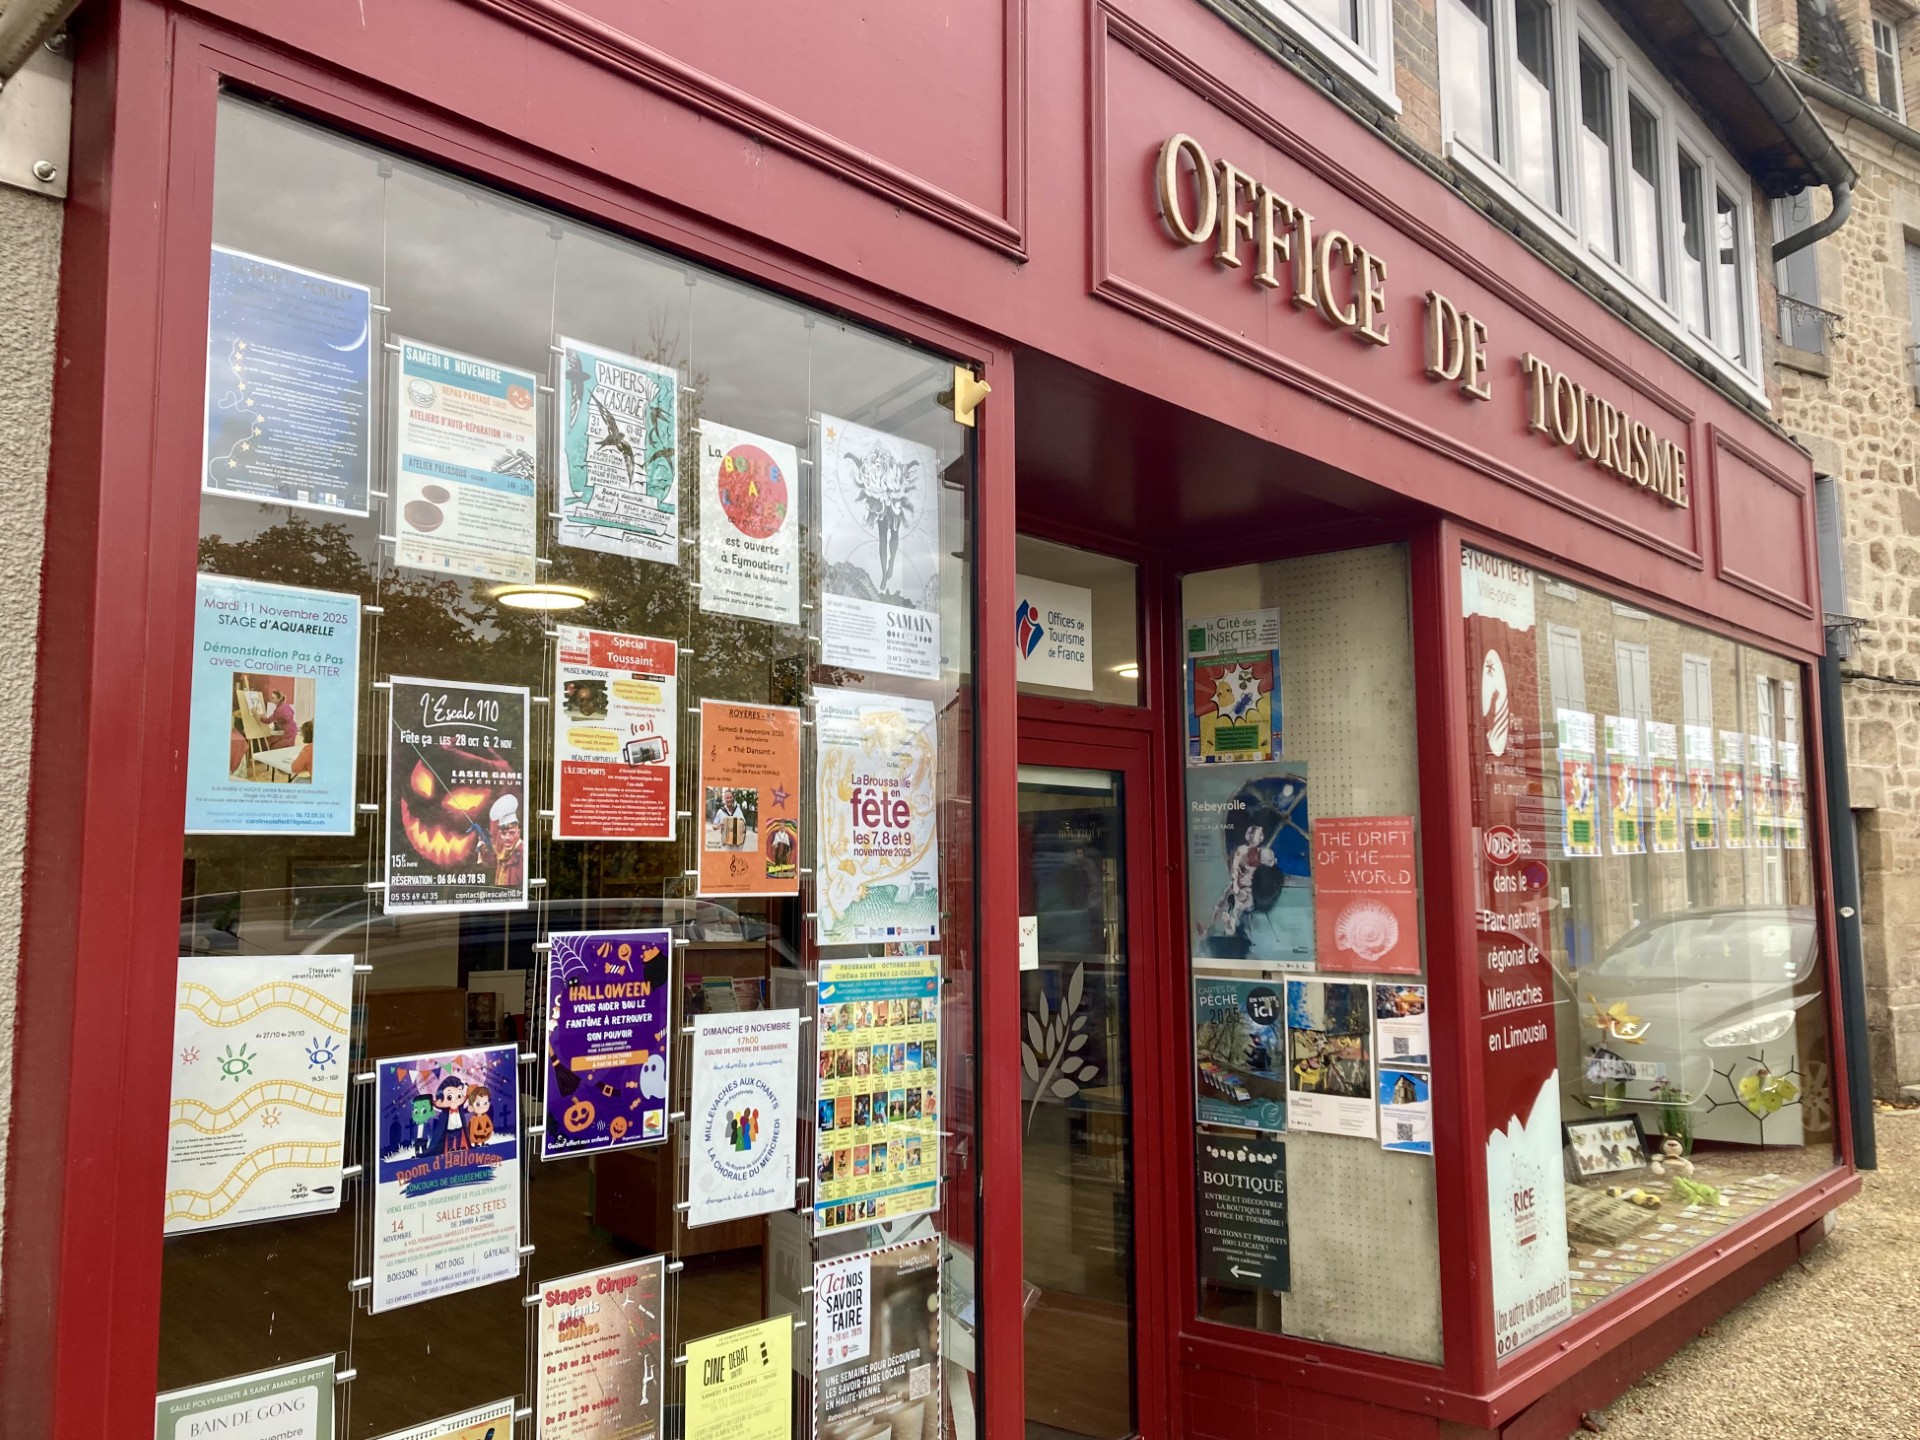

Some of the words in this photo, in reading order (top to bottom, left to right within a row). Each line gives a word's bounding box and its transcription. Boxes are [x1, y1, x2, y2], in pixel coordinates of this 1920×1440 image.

[1158, 133, 1389, 346] OFFICE
[1425, 289, 1491, 401] DE
[1519, 352, 1689, 509] TOURISME
[407, 347, 440, 368] SAMEDI
[444, 359, 449, 370] 8
[455, 360, 502, 383] NOVEMBRE
[598, 364, 644, 393] PAPIERS
[604, 388, 644, 417] CASCADE
[409, 409, 439, 424] ATELIERS
[709, 445, 722, 458] La
[409, 458, 436, 470] ATELIER
[726, 537, 740, 548] est
[744, 541, 779, 555] ouverte
[721, 551, 727, 563] à
[732, 555, 784, 573] Eymoutiers
[1462, 548, 1529, 587] EYMOUTIERS
[204, 599, 239, 611] Mardi
[244, 602, 254, 613] 11
[260, 605, 319, 620] Novembre
[323, 612, 348, 624] 2025
[1048, 611, 1075, 629] Offices
[1077, 621, 1084, 630] de
[219, 615, 257, 628] STAGE
[260, 620, 334, 637] d'AQUARELLE
[887, 611, 932, 633] SAMAÏN
[1217, 618, 1240, 629] Cité
[614, 637, 647, 649] Spécial
[1048, 628, 1084, 646] Tourisme
[1208, 629, 1257, 643] INSECTES
[203, 642, 288, 659] Démonstration
[292, 651, 310, 662] Pas
[314, 652, 321, 662] à
[325, 654, 344, 665] Pas
[607, 652, 653, 666] Toussaint
[1048, 648, 1055, 657] de
[1058, 646, 1084, 662] France
[210, 656, 240, 667] avec
[245, 659, 293, 672] Caroline
[297, 665, 340, 677] PLATTER
[420, 693, 476, 728] L'Escale
[477, 700, 499, 722] 110
[400, 730, 419, 744] Fête
[439, 736, 450, 745] LES
[455, 734, 466, 746] 28
[468, 737, 479, 747] OCT
[747, 747, 770, 755] Dansant
[451, 770, 488, 778] LASER
[492, 771, 522, 780] GAME
[852, 774, 861, 785] La
[850, 787, 911, 829] fête
[1192, 800, 1246, 812] Rebeyrolle
[853, 831, 869, 845] les
[872, 832, 880, 847] 7,
[883, 832, 890, 845] 8
[892, 833, 902, 845] et
[904, 832, 911, 845] 9
[1320, 832, 1351, 846] THE
[1358, 831, 1410, 846] DRIFT
[1484, 833, 1509, 854] Vous
[1512, 832, 1532, 854] êtes
[854, 847, 893, 856] novembre
[894, 848, 911, 856] 2025
[1318, 851, 1340, 865] OF
[1346, 851, 1379, 864] THE
[392, 873, 432, 885] RÉSERVATION
[447, 874, 456, 884] 84
[1344, 870, 1411, 884] WORLD
[1494, 871, 1516, 892] dans
[1519, 871, 1528, 891] le
[1484, 910, 1506, 931] Parc
[1508, 907, 1540, 929] naturel
[1488, 944, 1526, 972] régional
[1528, 943, 1539, 964] de
[569, 982, 651, 1001] HALLOWEEN
[1200, 994, 1238, 1006] PÊCHE
[1488, 983, 1542, 1011] Millevaches
[573, 1003, 596, 1013] VIENS
[598, 1002, 619, 1011] AIDER
[622, 1001, 636, 1009] BOU
[637, 1000, 646, 1008] LE
[1210, 1007, 1239, 1025] 2025
[566, 1016, 602, 1029] FANTÔME
[604, 1015, 610, 1025] À
[612, 1013, 652, 1024] RETROUVER
[703, 1026, 743, 1036] DIMANCHE
[745, 1025, 749, 1033] 9
[751, 1022, 791, 1032] NOVEMBRE
[587, 1032, 602, 1041] SON
[604, 1029, 633, 1040] POUVOIR
[737, 1036, 758, 1045] 17h00
[1489, 1033, 1501, 1051] en
[1504, 1020, 1547, 1049] Limousin
[705, 1080, 738, 1142] MILLEVACHES
[740, 1077, 754, 1086] AUX
[755, 1080, 779, 1110] CHANTS
[714, 1160, 746, 1181] CHORALE
[749, 1168, 759, 1178] DU
[759, 1118, 780, 1169] MERCREDI
[433, 1150, 503, 1170] d'Halloween
[1203, 1171, 1284, 1194] BOUTIQUE
[1205, 1192, 1231, 1201] ENTREZ
[1243, 1196, 1283, 1209] DÉCOUVREZ
[1227, 1204, 1261, 1214] BOUTIQUE
[1514, 1188, 1535, 1215] RICE
[436, 1208, 461, 1222] SALLE
[465, 1204, 480, 1216] DES
[483, 1199, 507, 1212] FETES
[1206, 1210, 1234, 1220] L'OFFICE
[1246, 1216, 1281, 1226] TOURISME
[392, 1219, 404, 1232] 14
[383, 1231, 412, 1243] NOVEMBRE
[1205, 1228, 1242, 1238] CRÉATIONS
[1253, 1235, 1287, 1245] PRODUITS
[387, 1268, 418, 1282] BOISSONS
[435, 1260, 447, 1270] HOT
[449, 1257, 464, 1267] DOGS
[484, 1247, 510, 1259] GÂTEAUX
[545, 1284, 591, 1307] Stages
[597, 1274, 639, 1296] Cirque
[823, 1269, 846, 1295] Ici
[846, 1271, 863, 1289] NOS
[827, 1289, 862, 1314] SAVOIR
[1496, 1310, 1507, 1335] Une
[1509, 1300, 1525, 1326] autre
[1526, 1295, 1534, 1317] vie
[1536, 1284, 1559, 1314] s'invente
[559, 1362, 568, 1371] 20
[581, 1355, 590, 1364] 22
[704, 1356, 725, 1386] CINE
[729, 1346, 748, 1370] DEBAT
[826, 1376, 838, 1387] UNE
[840, 1366, 868, 1382] SEMAINE
[870, 1360, 886, 1372] POUR
[826, 1387, 836, 1399] LES
[839, 1374, 880, 1394] SAVOIR-FAIRE
[882, 1365, 905, 1380] LOCAUX
[170, 1403, 190, 1413] SALLE
[192, 1391, 241, 1407] POLYVALENTE
[250, 1385, 270, 1394] SAINT
[272, 1378, 298, 1389] AMAND
[308, 1372, 324, 1381] PETIT
[836, 1384, 881, 1406] HAUTE-VIENNE
[191, 1416, 228, 1437] BAIN
[232, 1410, 252, 1427] DE
[258, 1397, 305, 1420] GONG
